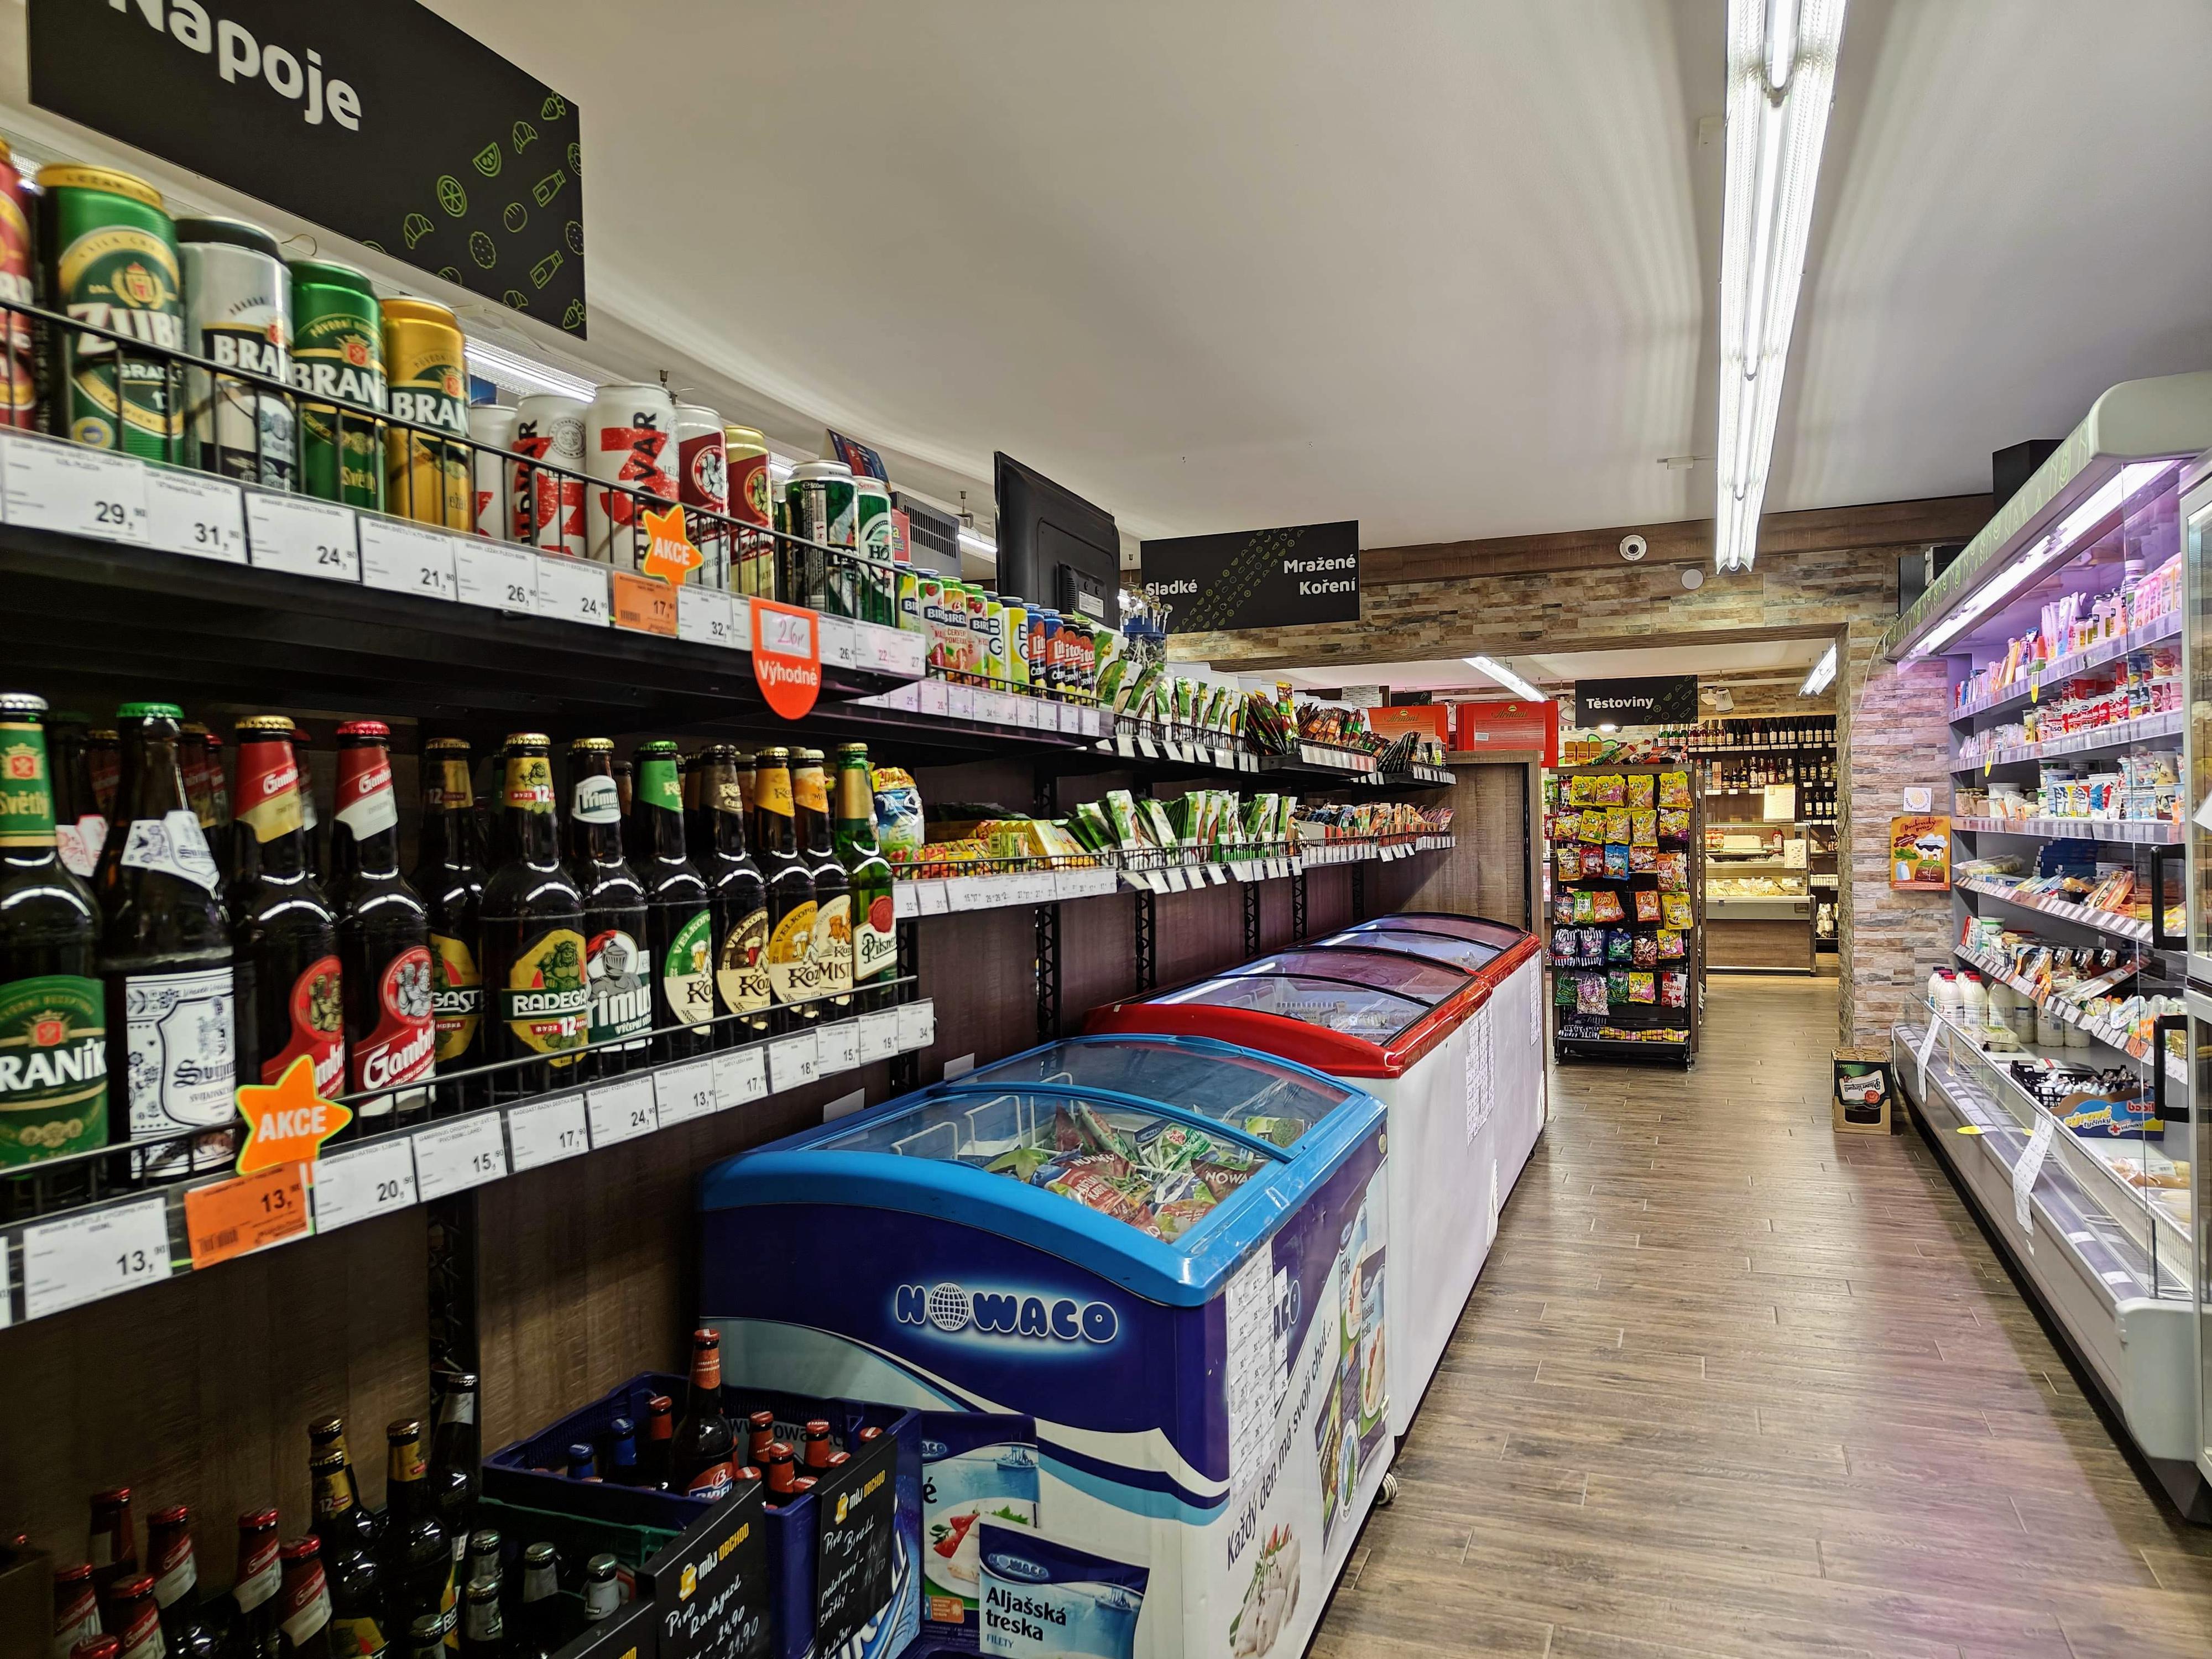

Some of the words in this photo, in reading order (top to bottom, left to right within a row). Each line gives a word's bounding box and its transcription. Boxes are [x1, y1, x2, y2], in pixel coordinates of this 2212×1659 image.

[654, 537, 690, 566] AKCE
[1283, 555, 1357, 575] Mražené
[1146, 578, 1198, 597] Sladké
[1299, 578, 1357, 596] Koření
[758, 659, 818, 687] Výhodné
[1585, 696, 1655, 710] Těstoviny
[582, 786, 618, 810] Primus
[1663, 983, 1682, 992] Slavia
[560, 1016, 577, 1037] 12
[257, 1105, 327, 1143] AKCE
[2084, 1118, 2111, 1129] tyčinky
[1340, 1252, 1352, 1285] Filé
[863, 1468, 886, 1499] OBCHOD
[1227, 1490, 1259, 1572] Každý
[1260, 1460, 1277, 1511] den
[1277, 1420, 1293, 1470] má
[1292, 1369, 1311, 1434] svoji
[718, 1521, 750, 1562] OBCHOD
[986, 1586, 1067, 1627] Aljašská
[986, 1610, 1045, 1642] treska
[986, 1633, 1015, 1650] FILETY
